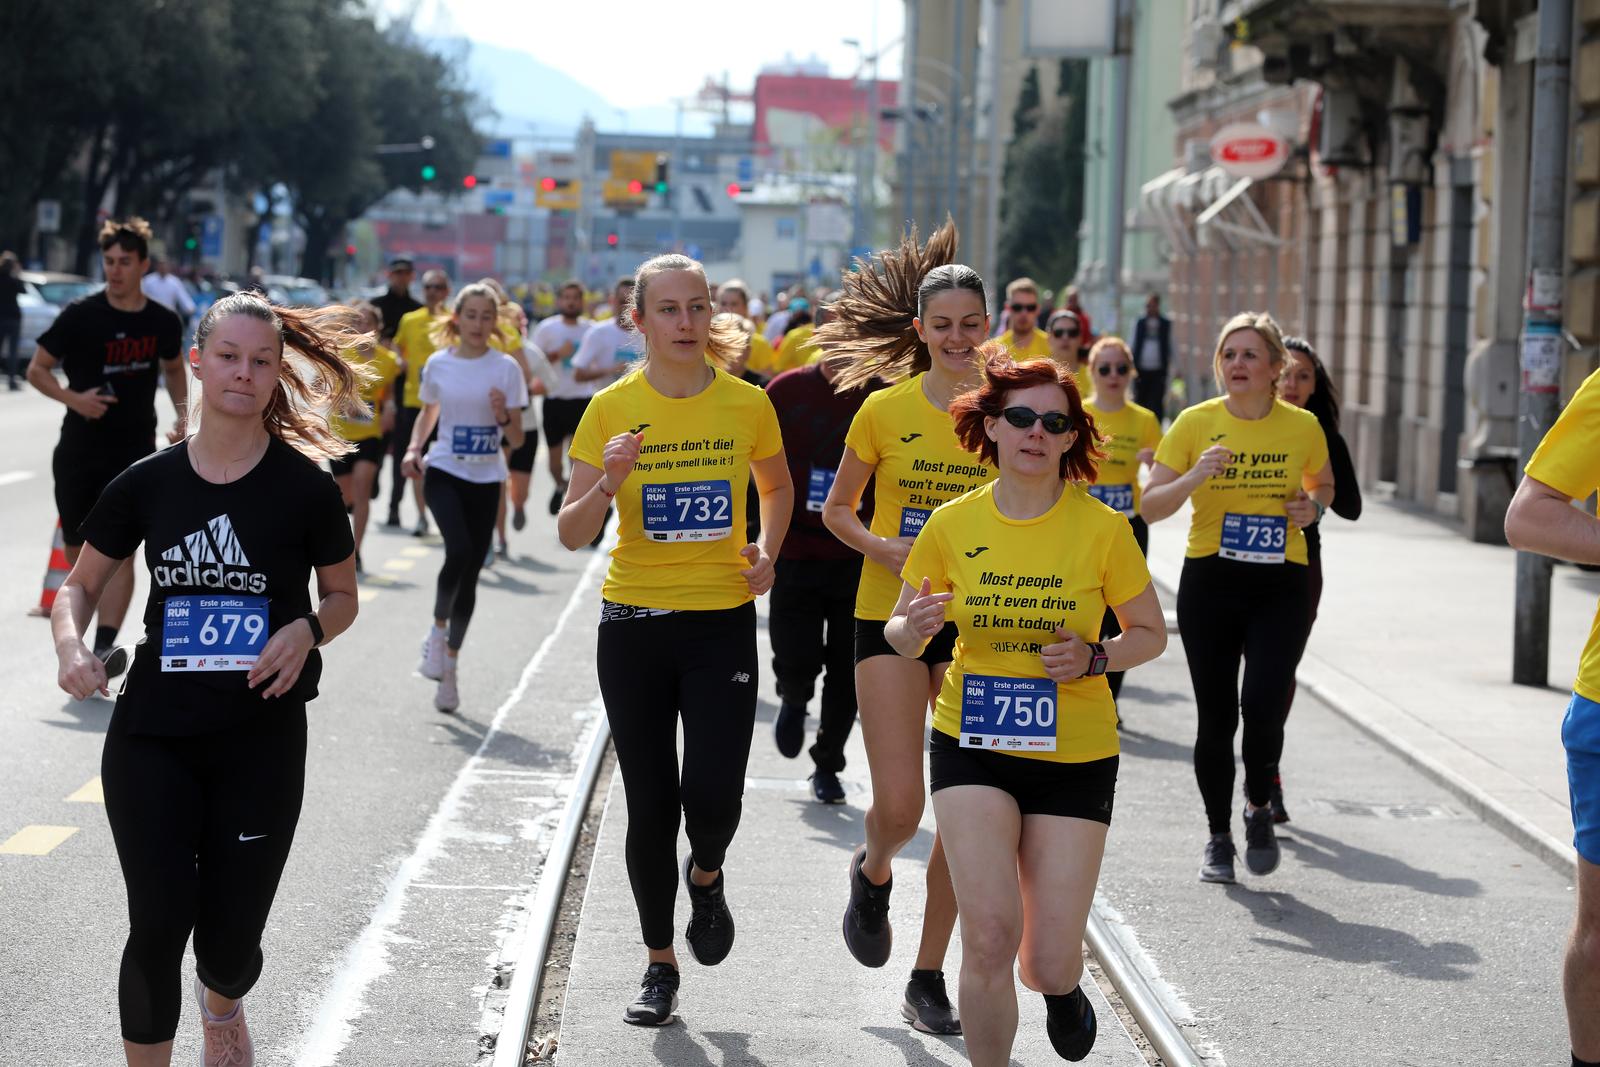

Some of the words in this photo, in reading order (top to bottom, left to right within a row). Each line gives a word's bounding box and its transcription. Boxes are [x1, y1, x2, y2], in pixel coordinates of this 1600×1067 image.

[639, 443, 679, 454] unners
[681, 439, 711, 453] don't
[713, 438, 734, 451] die!
[655, 460, 673, 471] only
[676, 457, 699, 468] smell
[702, 456, 717, 467] like
[719, 456, 726, 466] it
[1230, 452, 1247, 464] ot
[1250, 453, 1288, 466] your
[912, 459, 944, 472] Most
[946, 464, 988, 478] people
[1243, 469, 1288, 479] race.
[693, 485, 711, 493] petica
[898, 478, 933, 490] won't
[936, 482, 965, 493] even
[909, 494, 922, 504] 21
[925, 496, 943, 507] km
[676, 495, 729, 522] 732
[905, 517, 924, 526] RUN
[1246, 526, 1285, 548] 733
[154, 561, 267, 594] adidas
[980, 572, 1014, 586] Most
[1016, 575, 1063, 590] people
[221, 600, 243, 610] petica
[965, 593, 1001, 606] won't
[1004, 596, 1037, 608] even
[1041, 596, 1077, 611] drive
[167, 608, 189, 618] RUN
[199, 614, 264, 646] 679
[973, 614, 988, 628] 21
[992, 615, 1014, 628] km
[1018, 617, 1065, 634] today!
[967, 687, 984, 697] RUN
[994, 681, 1011, 689] Erste
[1013, 682, 1035, 690] petica
[994, 695, 1054, 727] 750
[991, 738, 1000, 747] A1
